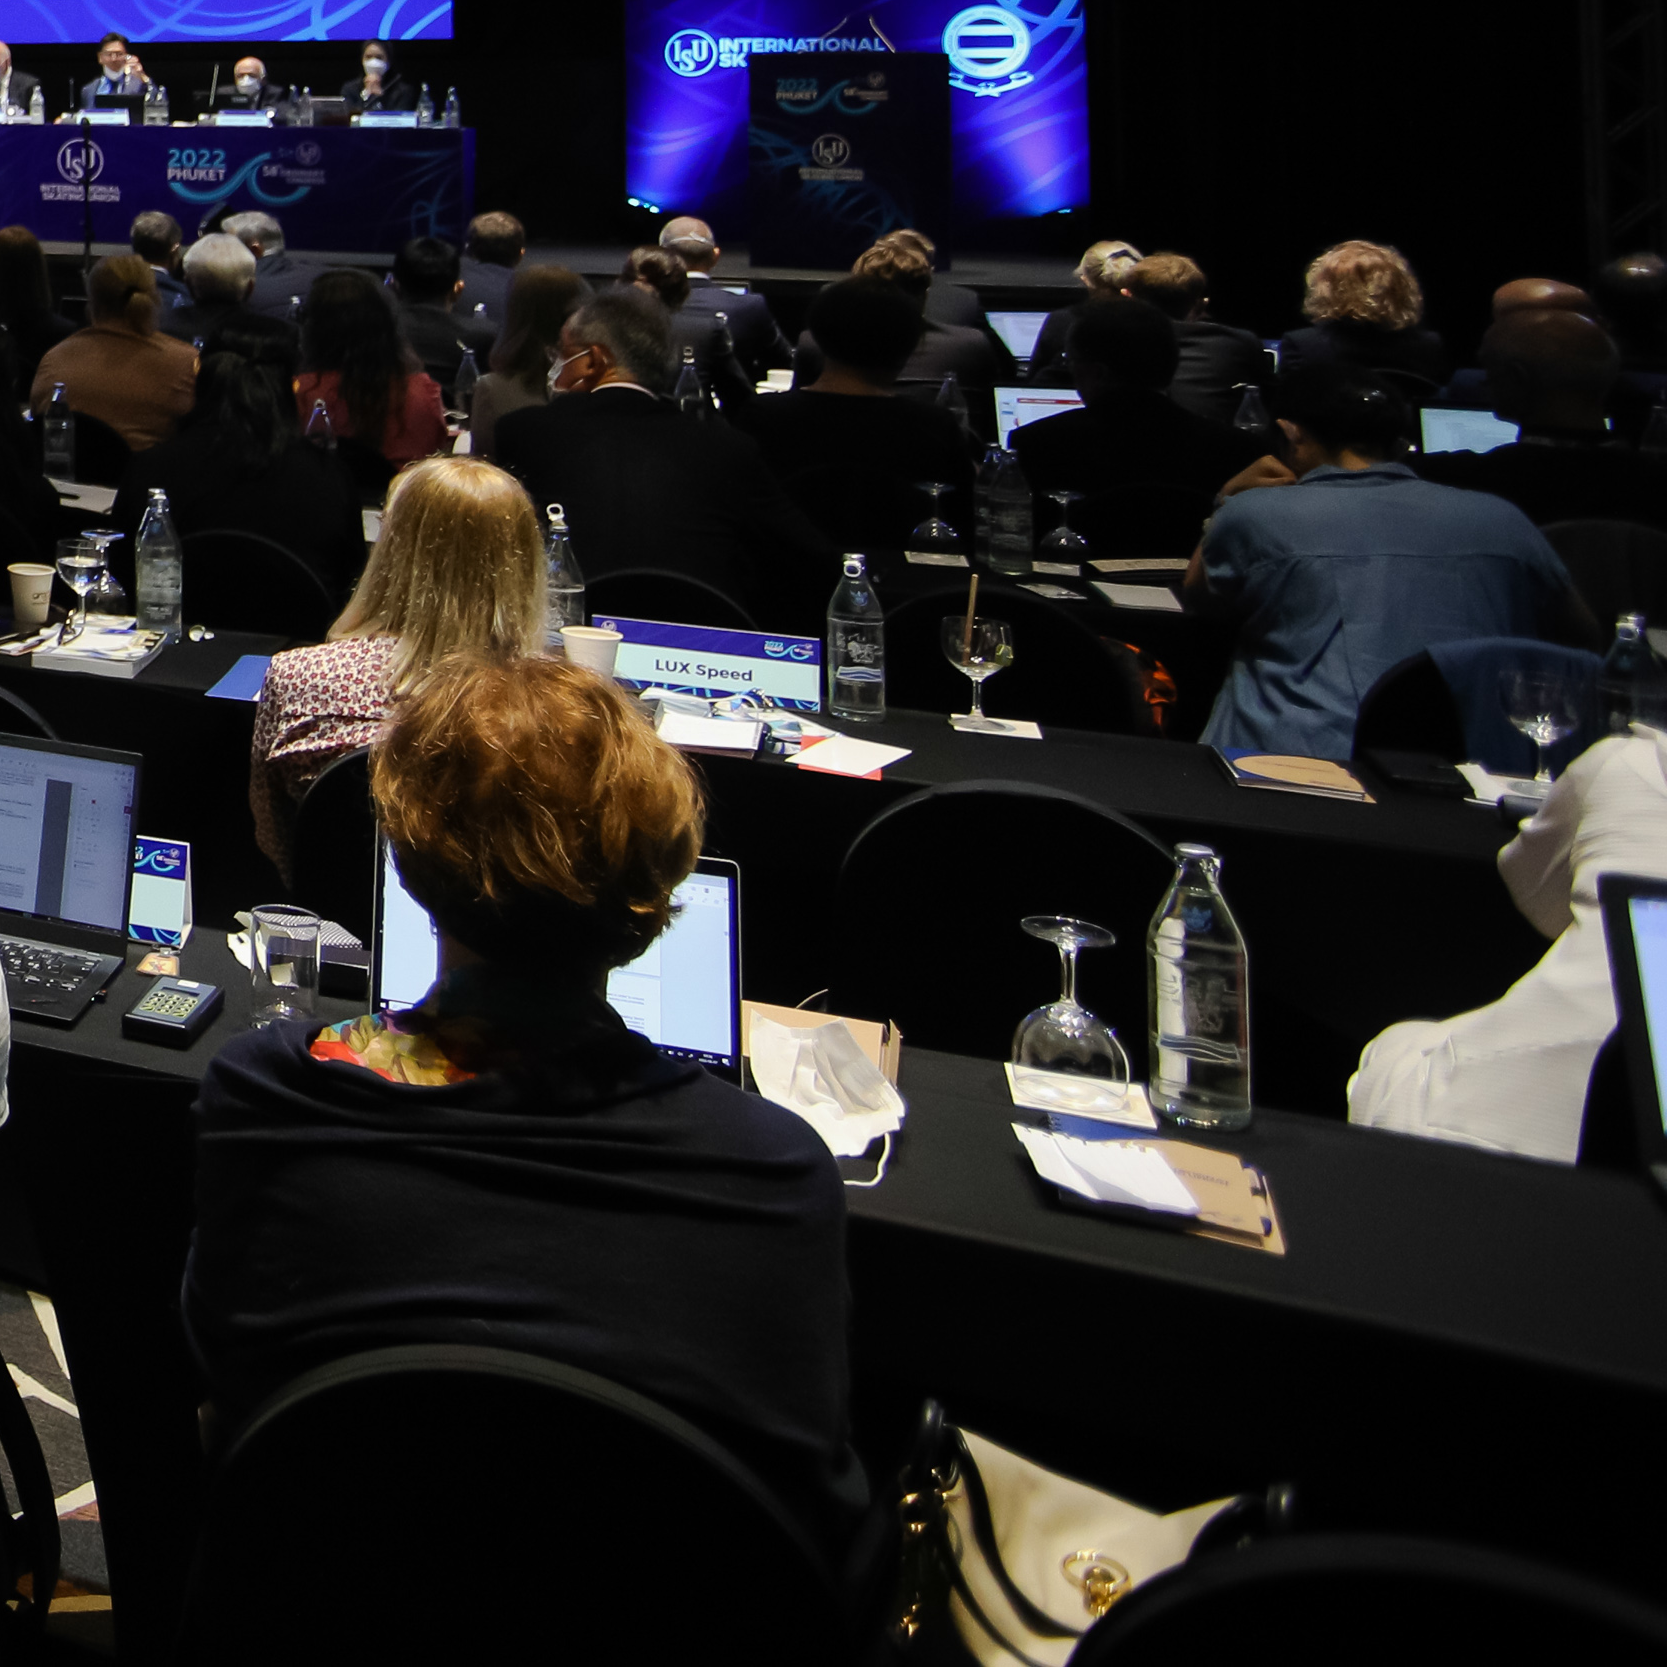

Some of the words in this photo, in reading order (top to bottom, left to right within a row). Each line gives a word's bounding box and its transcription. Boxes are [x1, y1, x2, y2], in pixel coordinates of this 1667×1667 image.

[718, 37, 885, 53] INTERNATIONAL
[776, 78, 818, 92] 2022
[168, 147, 226, 167] 2022
[167, 167, 226, 182] PHUKET
[655, 659, 691, 674] LUX
[696, 664, 753, 682] Speed
